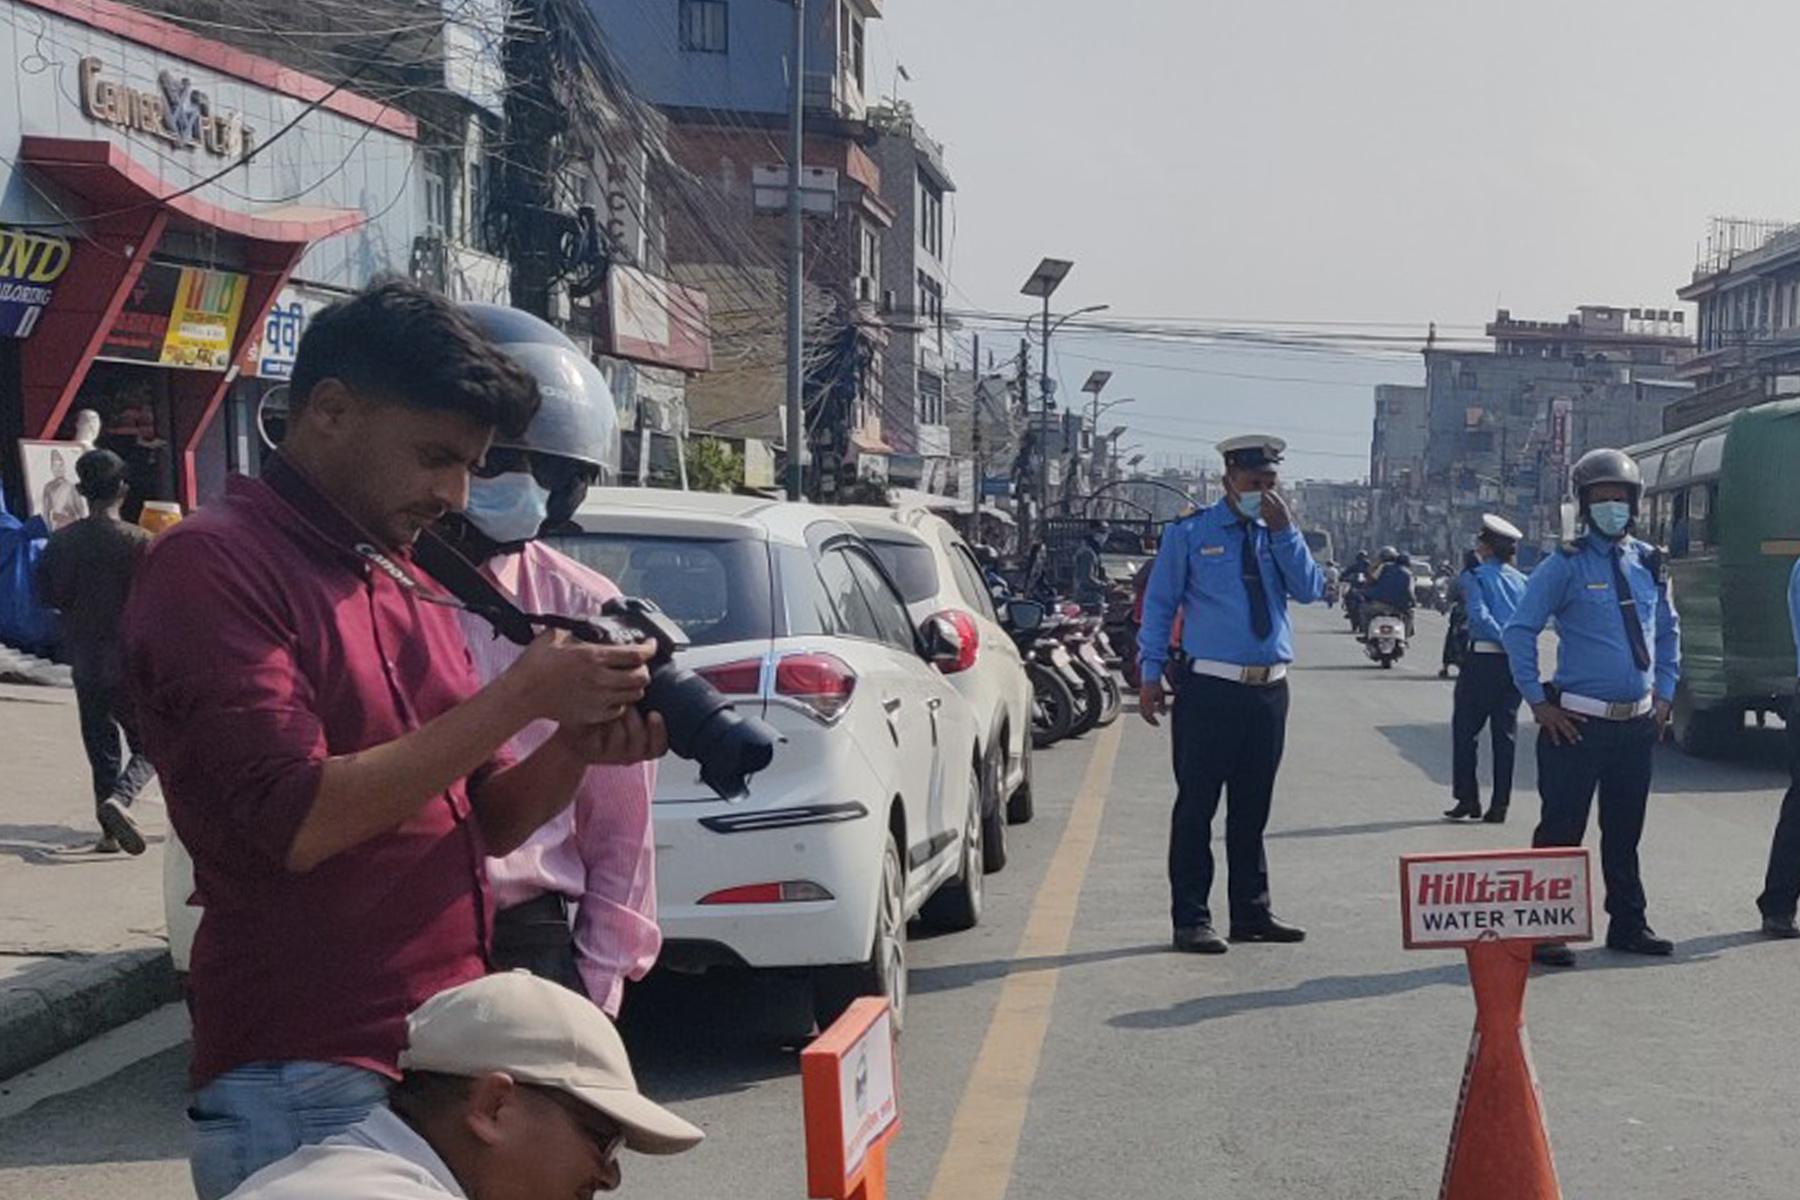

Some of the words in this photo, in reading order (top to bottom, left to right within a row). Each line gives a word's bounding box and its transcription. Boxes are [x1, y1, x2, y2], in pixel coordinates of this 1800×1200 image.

[0, 230, 71, 283] ND
[1418, 869, 1573, 905] Hilltake
[1422, 910, 1505, 931] WATER
[1514, 907, 1576, 927] TANK
